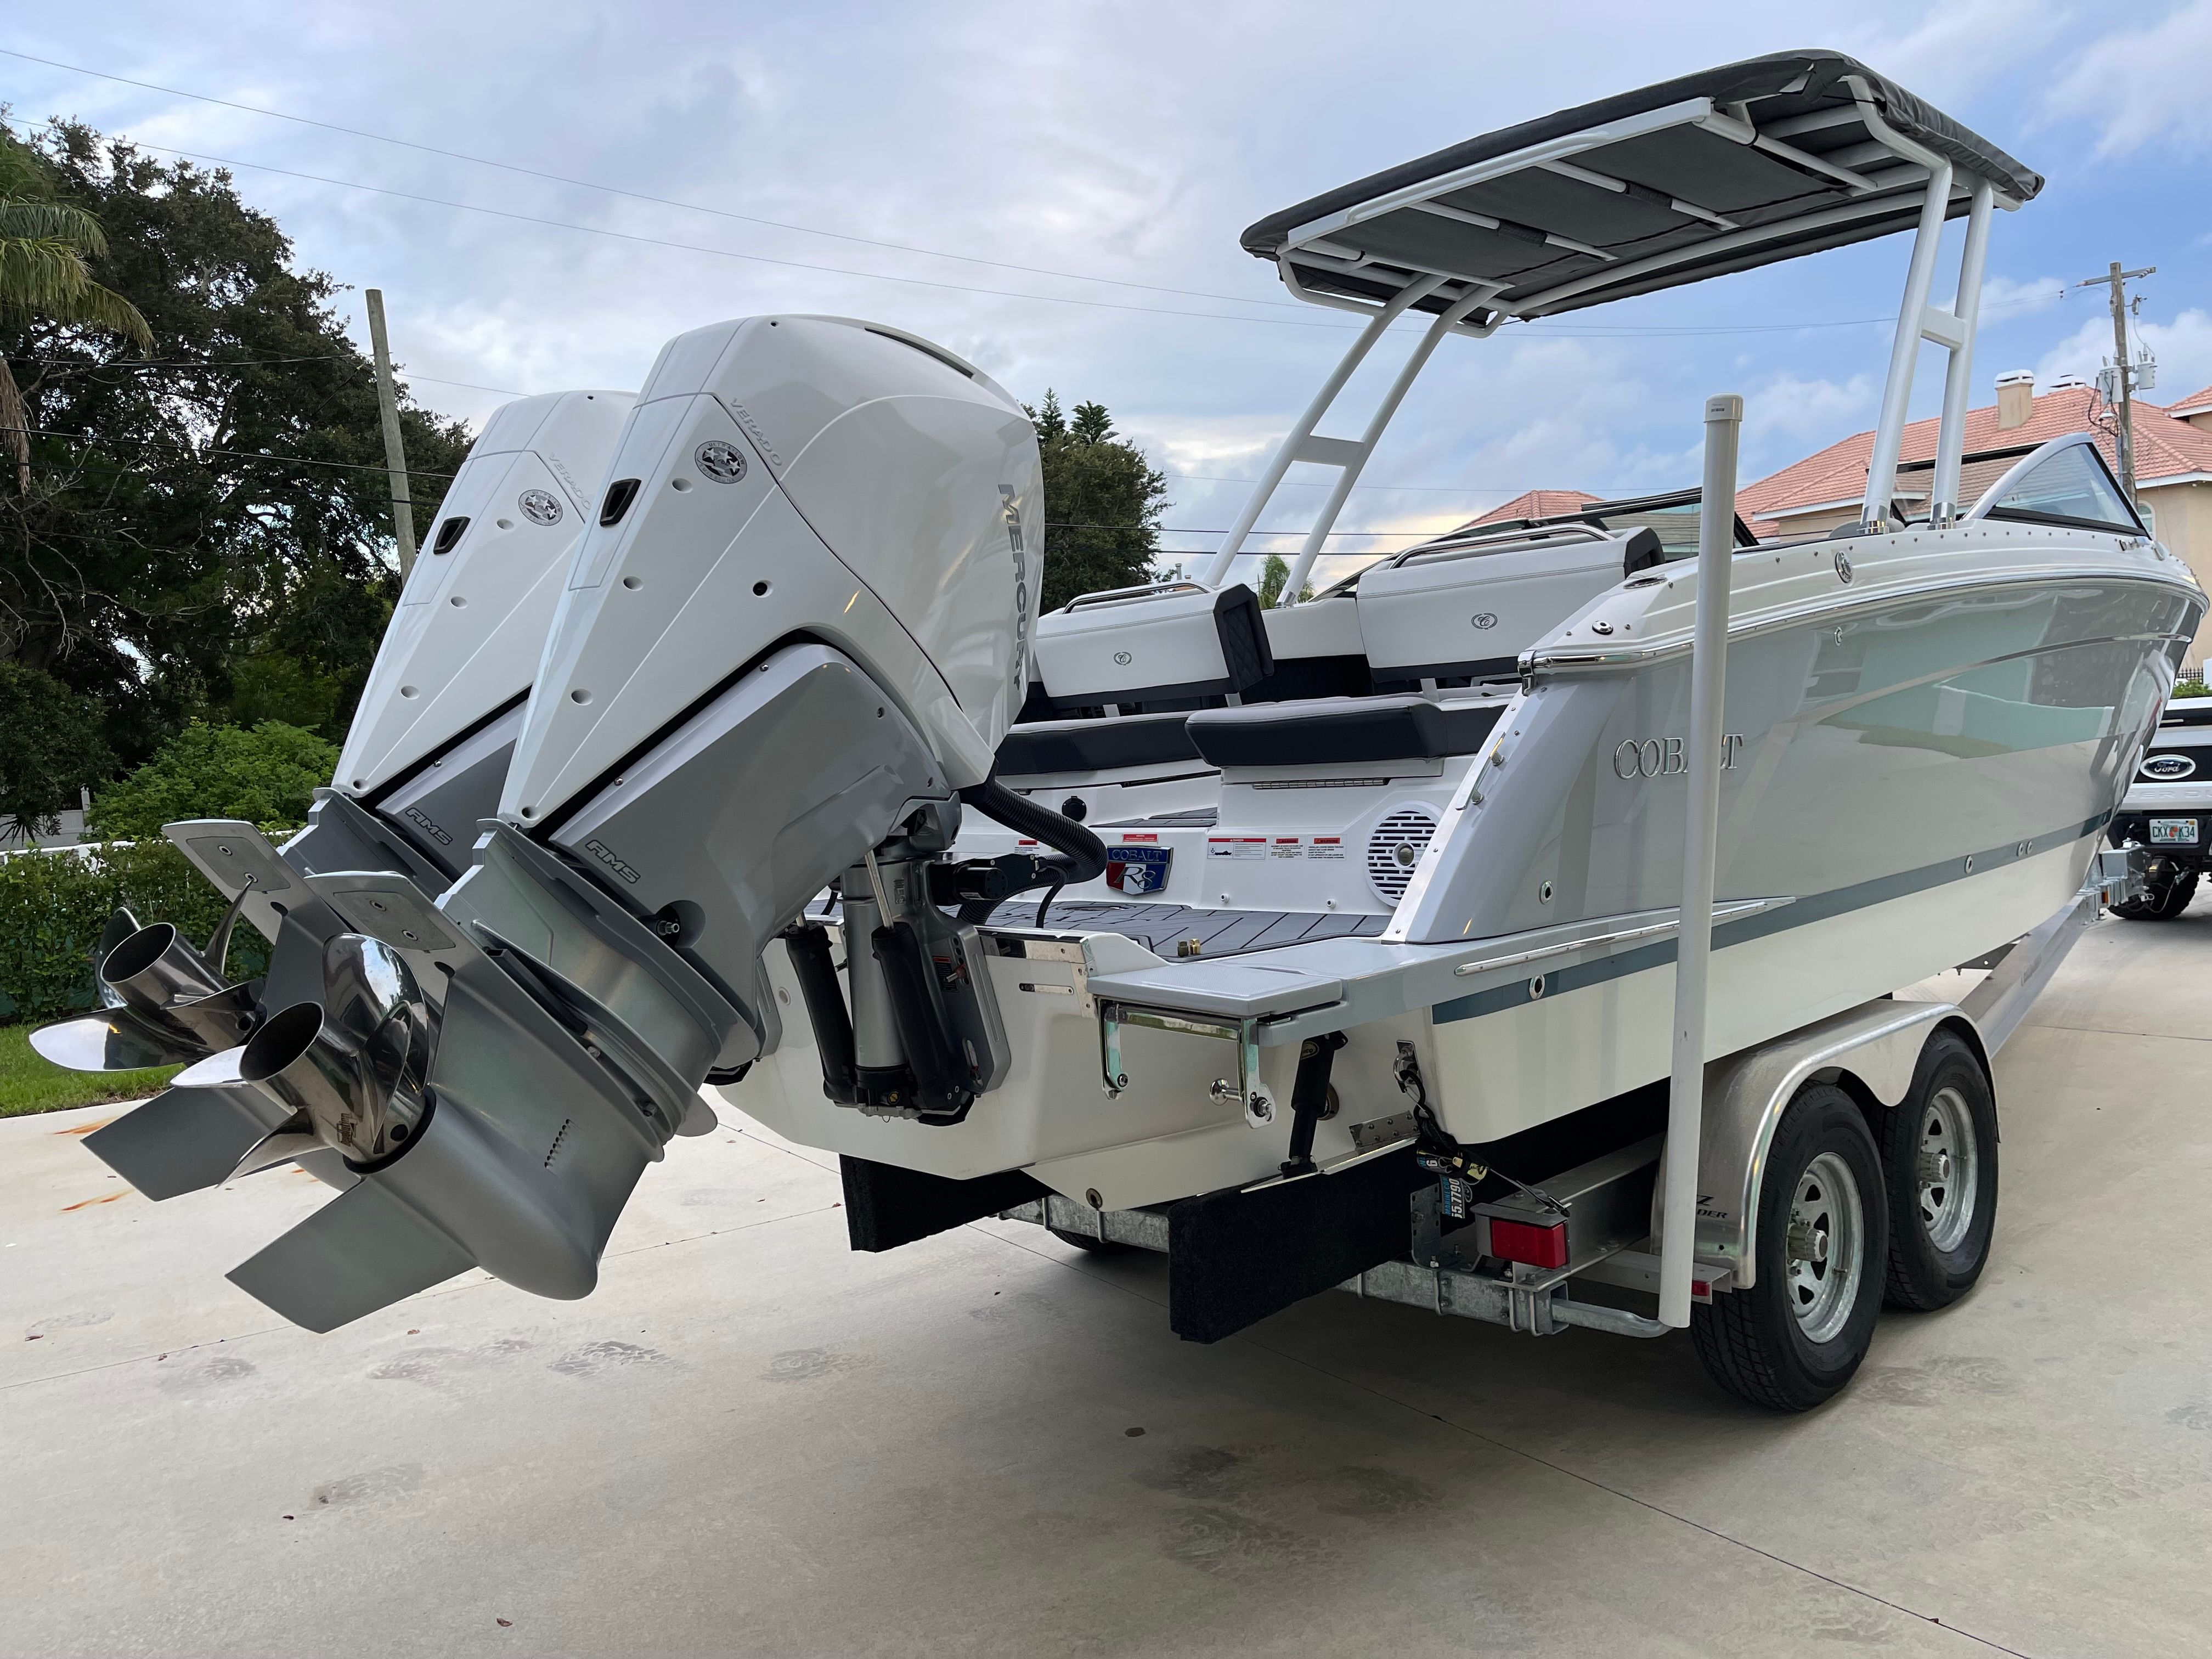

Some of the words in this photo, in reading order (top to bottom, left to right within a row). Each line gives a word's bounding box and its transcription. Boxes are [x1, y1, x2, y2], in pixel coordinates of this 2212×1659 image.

[730, 398, 783, 466] VERADO
[549, 452, 591, 510] VERADO
[997, 484, 1027, 691] MERCURY
[1615, 732, 1744, 780] COBT
[2154, 761, 2181, 773] Ford
[405, 808, 453, 845] AMS
[2152, 826, 2168, 838] CKX
[2179, 826, 2195, 838] K34
[585, 839, 641, 884] AMS
[1111, 849, 1163, 862] COBALT
[1113, 866, 1156, 890] R8
[1696, 1194, 1714, 1206] Z
[1697, 1209, 1728, 1218] DER
